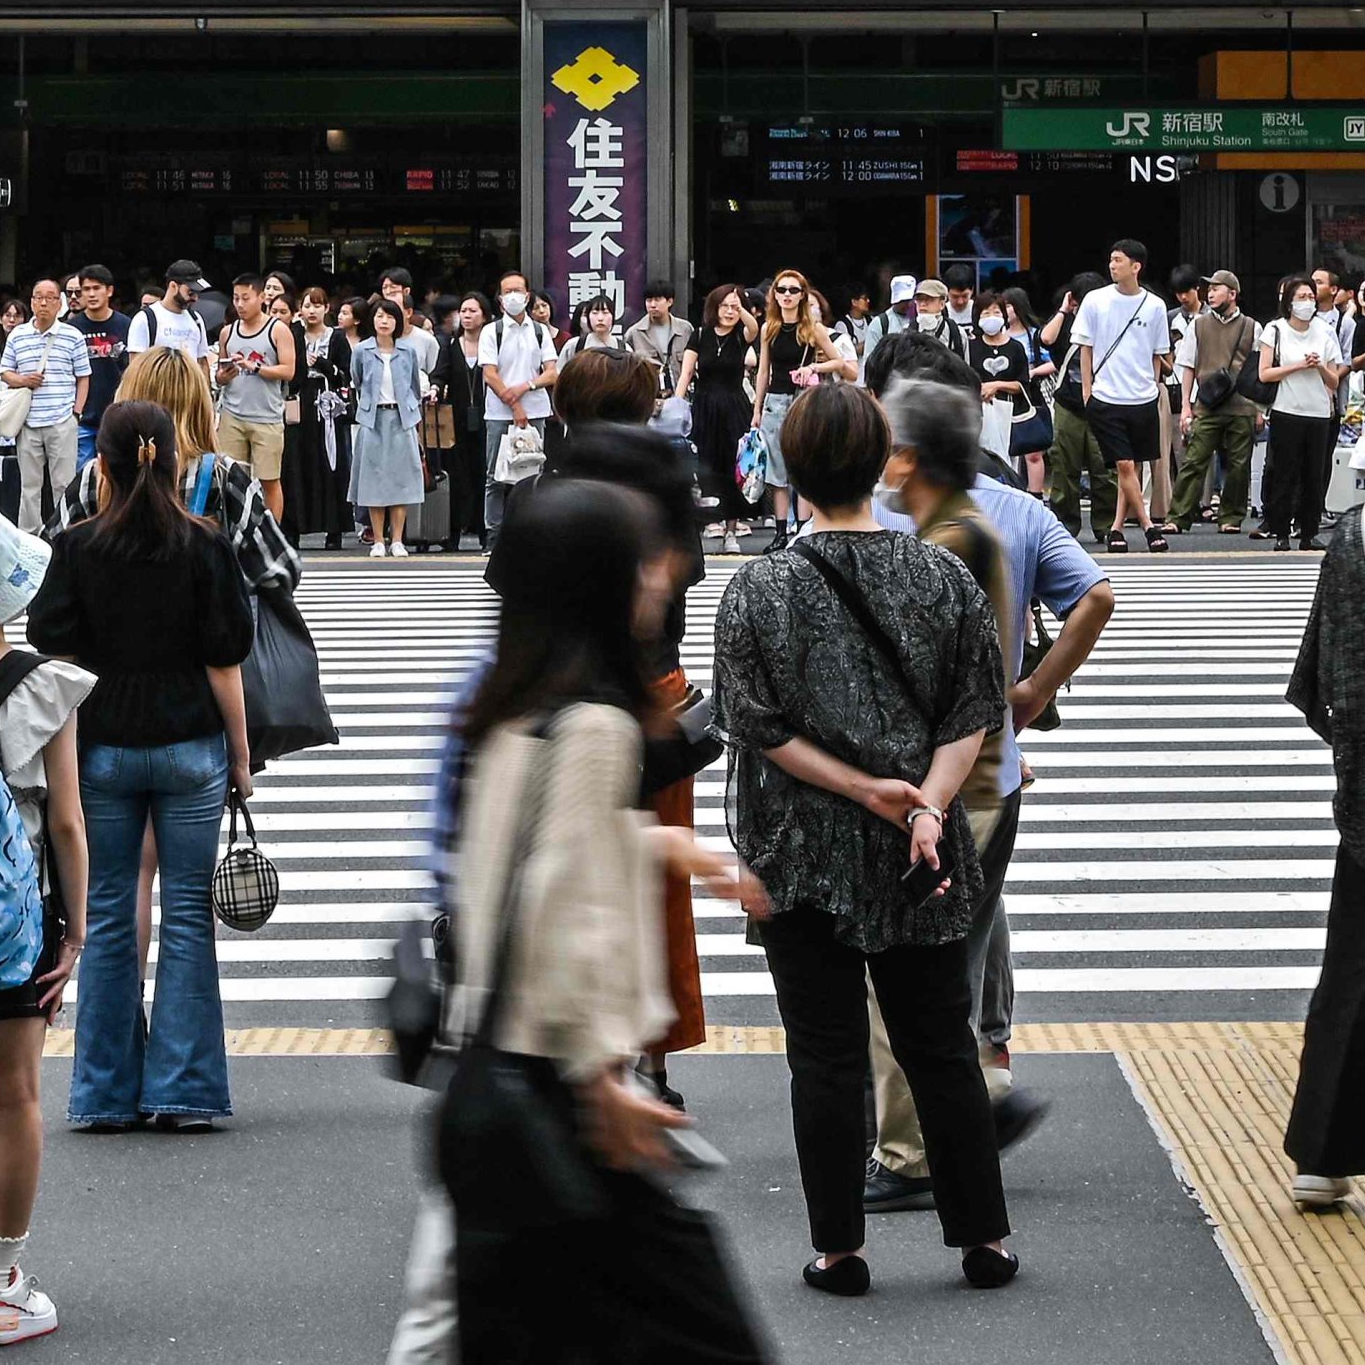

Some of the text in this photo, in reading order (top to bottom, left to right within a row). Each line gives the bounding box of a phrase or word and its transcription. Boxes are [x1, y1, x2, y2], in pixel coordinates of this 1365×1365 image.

[1106, 112, 1304, 137] JR 新宿駅 南改札
[1349, 123, 1363, 134] JY
[1162, 135, 1209, 147] Shinjuku
[1213, 135, 1251, 147] Station
[566, 118, 625, 340] 住友不動
